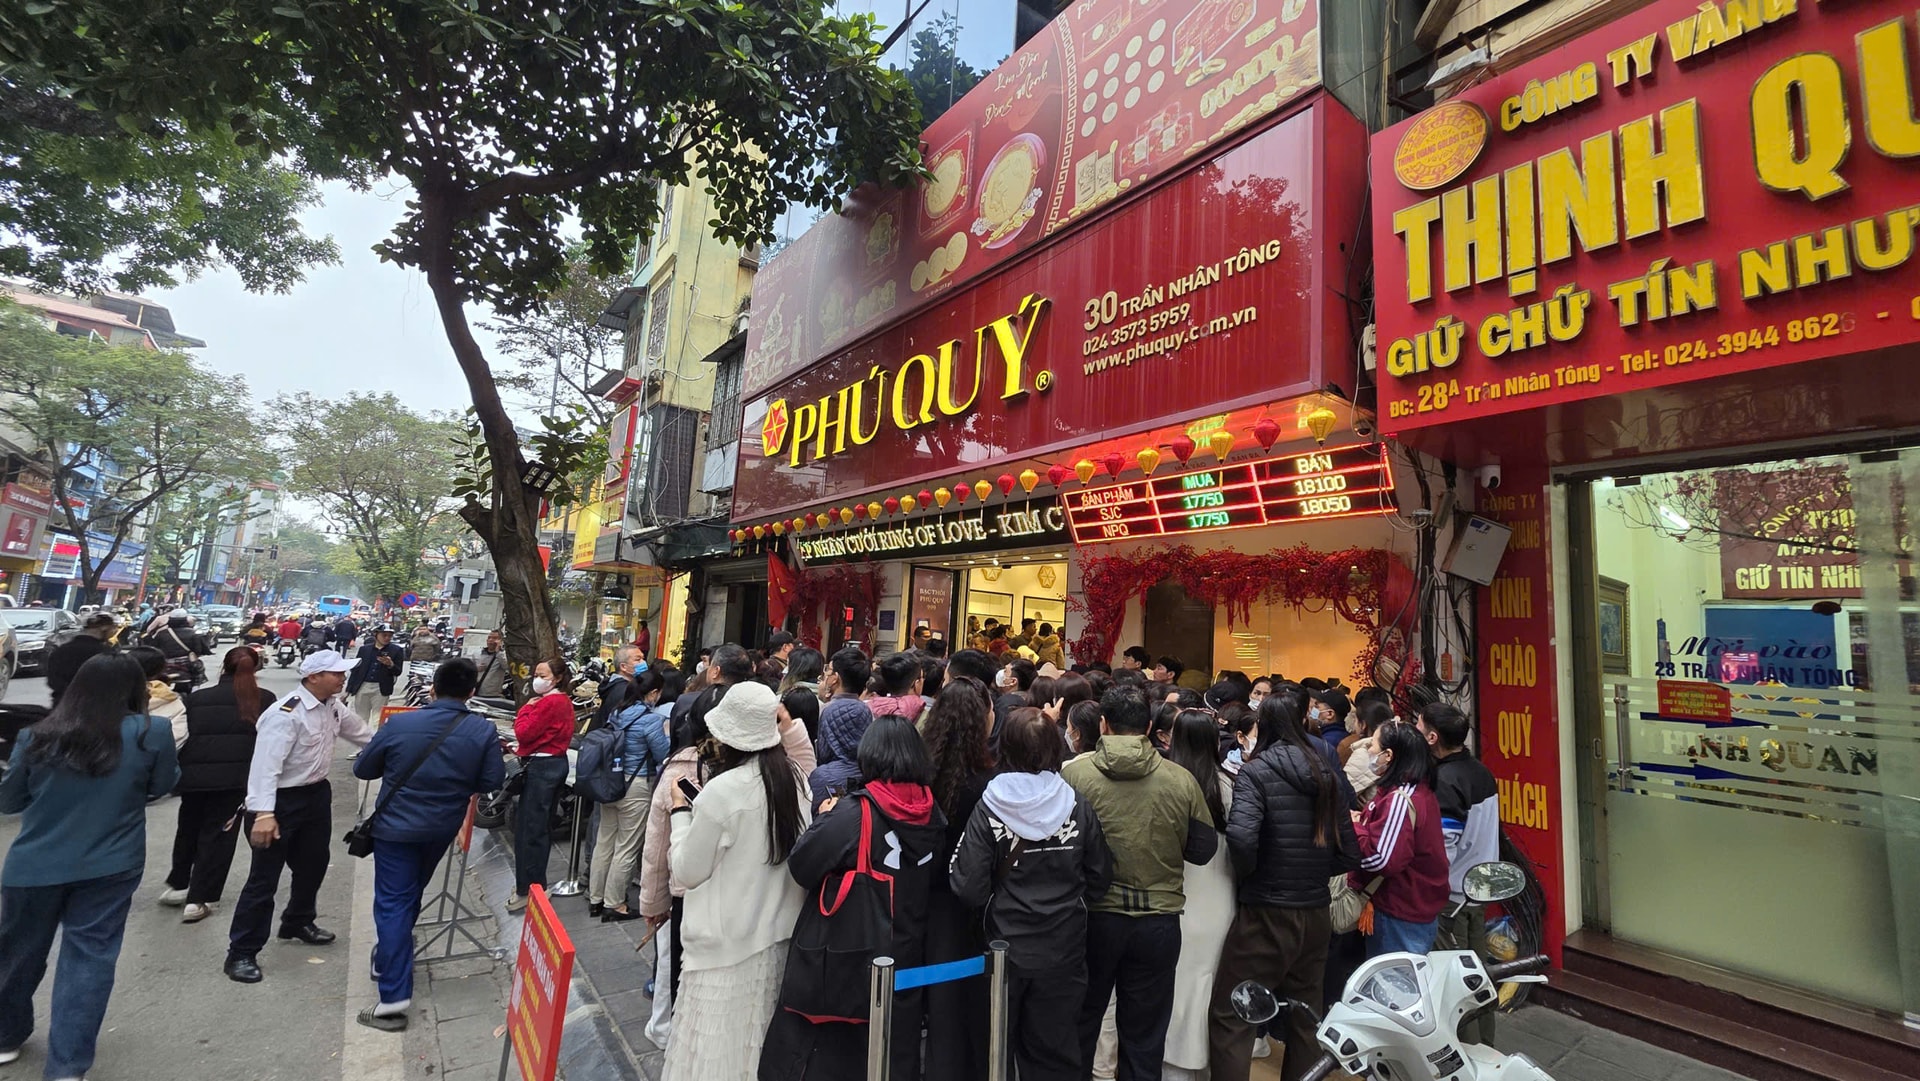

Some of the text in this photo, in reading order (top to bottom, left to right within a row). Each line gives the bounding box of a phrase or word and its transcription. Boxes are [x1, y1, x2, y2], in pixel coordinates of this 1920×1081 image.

[1500, 61, 1598, 132] CÔNG
[1606, 32, 1658, 88] TY
[1393, 97, 1706, 304] THỊNH
[1084, 239, 1281, 331] 30 TRẦN NHÂN TÔNG
[1386, 203, 1920, 378] GIỮ CHỮ TÍN NHƯ
[1083, 303, 1190, 356] 024 3573 5959
[1083, 306, 1257, 376] www.phuquy.com.vn
[788, 364, 890, 468] PHÚ
[892, 292, 1051, 430] QUÝ
[1504, 372, 1551, 397] Nhân
[1555, 364, 1601, 387] Tông
[1620, 349, 1660, 374] Tel:
[1664, 325, 1780, 366] 024.3944
[1183, 472, 1216, 490] MUA
[1296, 453, 1333, 474] BÁN
[1100, 474, 1347, 521] SJC 17750 18100
[1102, 495, 1352, 538] NPQ 17750 18050
[1520, 493, 1537, 509] TY
[880, 527, 915, 550] RING
[915, 525, 937, 546] OF
[938, 517, 987, 544] LOVE
[997, 509, 1046, 537] KIM
[1491, 570, 1532, 619] KÍNH
[1735, 563, 1773, 590] GIỮ
[1490, 637, 1537, 688] CHÀO
[1670, 636, 1746, 657] Mời
[1759, 638, 1832, 660] vào
[1655, 661, 1676, 678] 28
[1799, 664, 1860, 690] TÔNG
[1498, 705, 1533, 760] QUÝ
[1644, 729, 1750, 763] HỊNH
[1496, 773, 1549, 831] HÁCH
